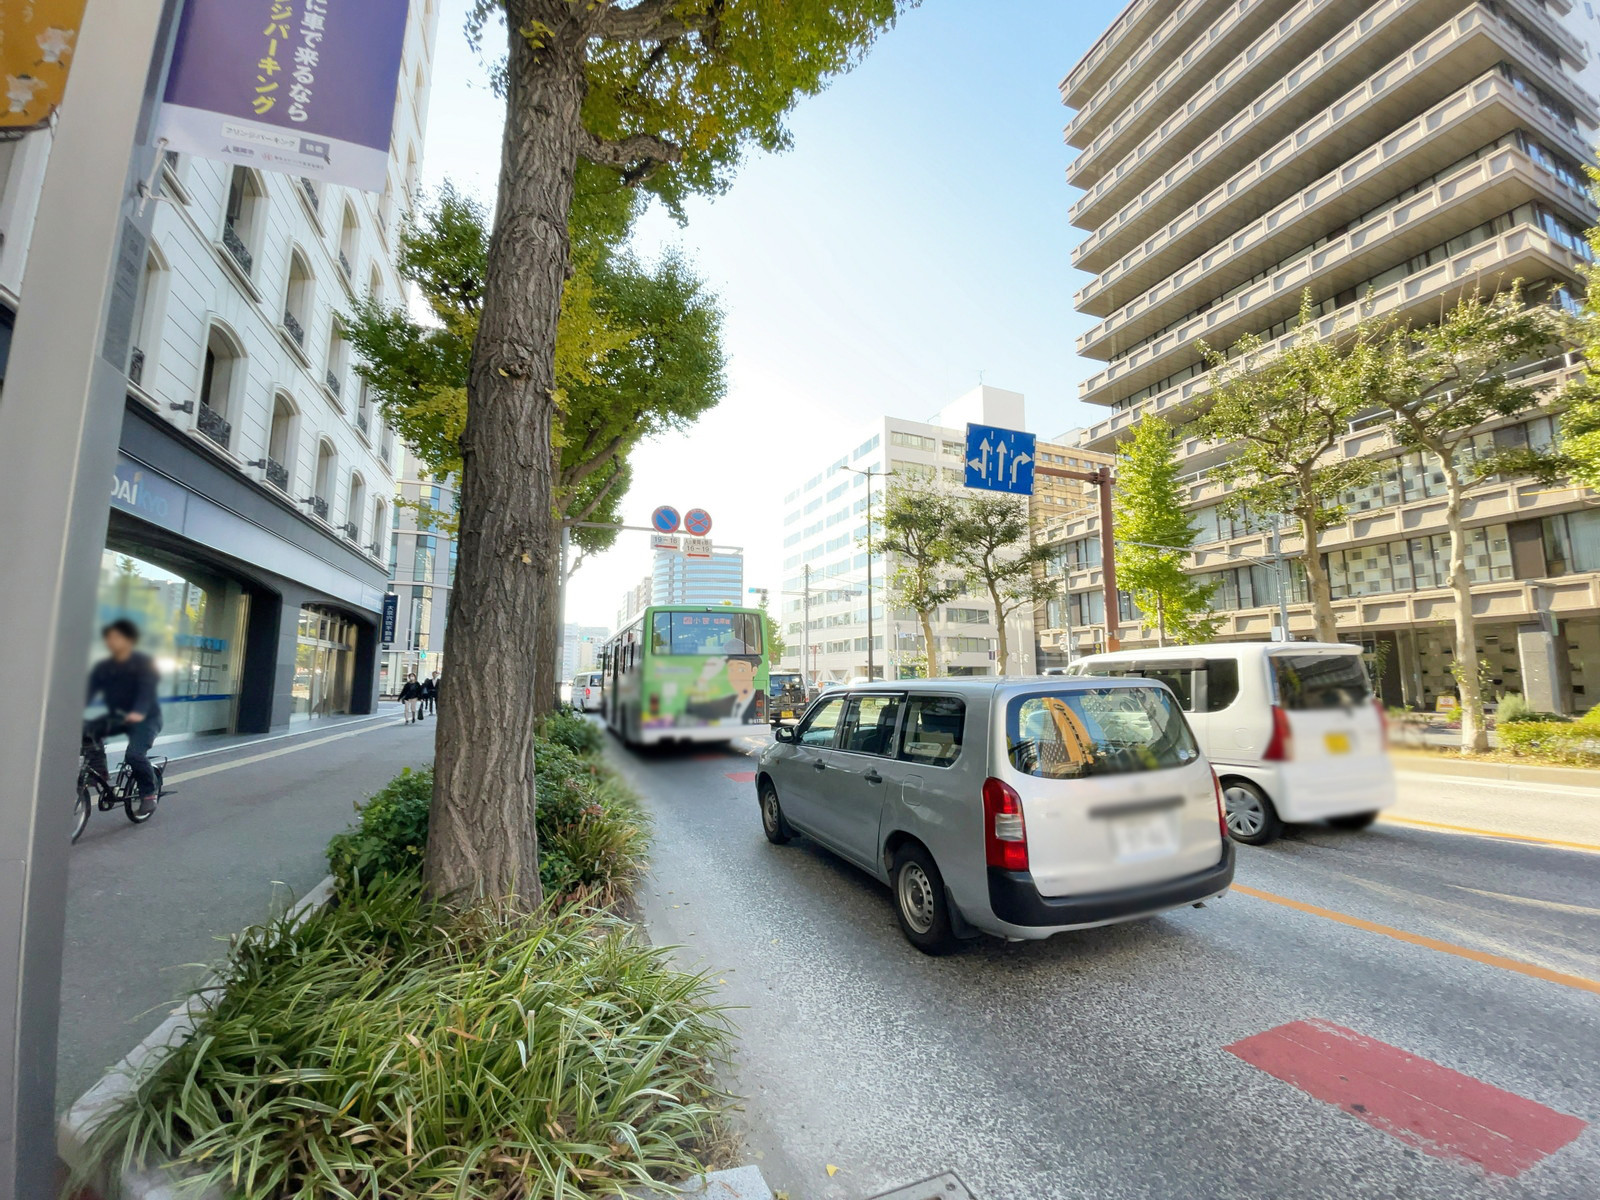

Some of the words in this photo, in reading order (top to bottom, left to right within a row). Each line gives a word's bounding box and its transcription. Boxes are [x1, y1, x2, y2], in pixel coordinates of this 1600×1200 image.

[252, 0, 293, 114] ジパーキング
